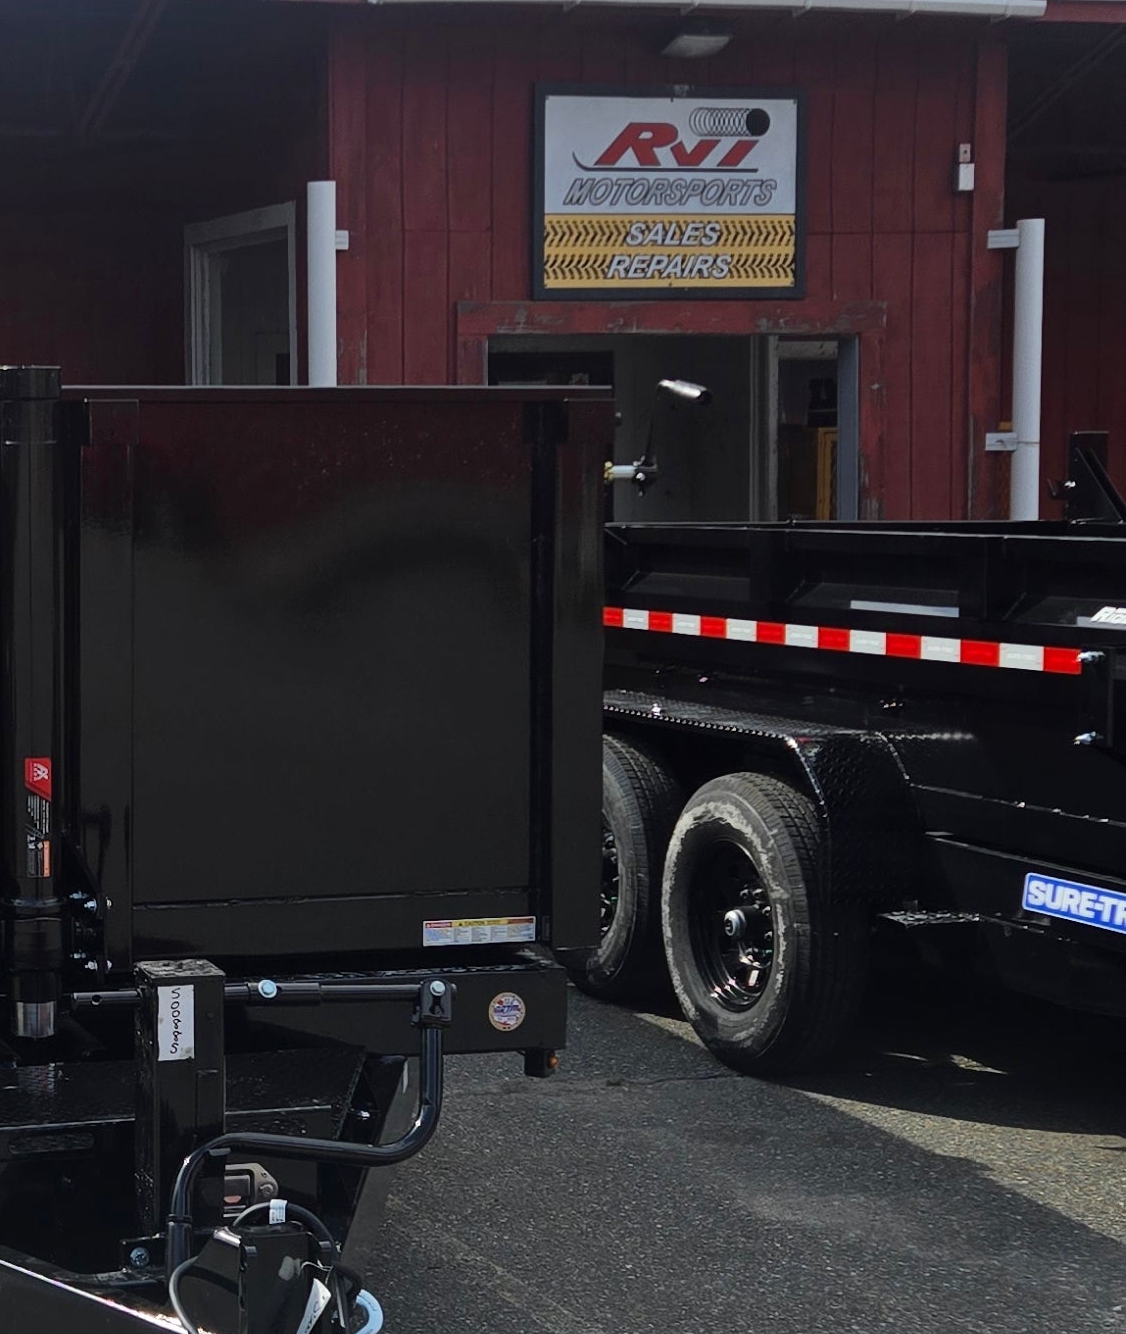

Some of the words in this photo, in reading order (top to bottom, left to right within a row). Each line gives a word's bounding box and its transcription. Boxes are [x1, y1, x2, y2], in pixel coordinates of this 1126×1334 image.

[563, 178, 777, 207] MOTORSPORTS
[625, 222, 722, 247] SALES
[606, 255, 732, 279] REPAIRS
